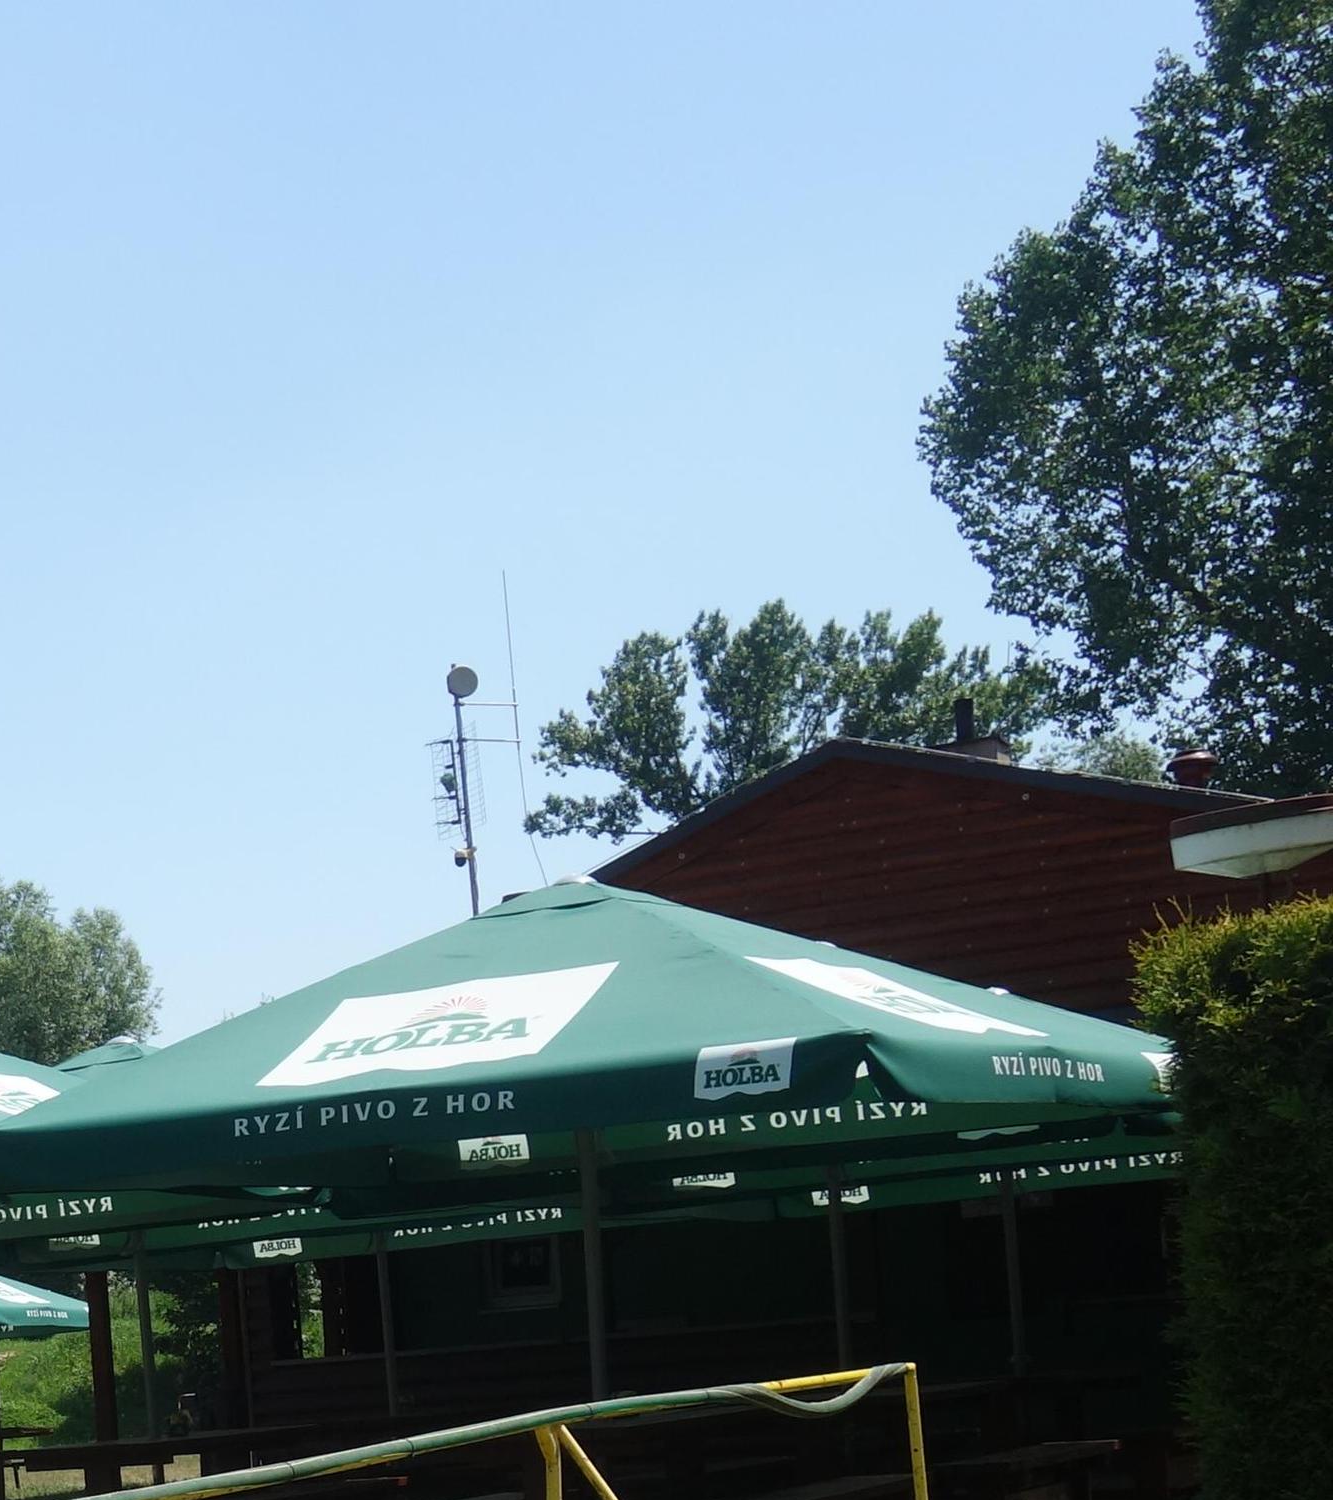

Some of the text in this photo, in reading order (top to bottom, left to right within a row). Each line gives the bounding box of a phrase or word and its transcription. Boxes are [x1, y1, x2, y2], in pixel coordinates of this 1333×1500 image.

[305, 1017, 532, 1063] HOLBA
[703, 1064, 780, 1089] HOLBA
[992, 1052, 1104, 1082] RYZÍ PIVO Z HOR
[233, 1090, 515, 1137] RYZÍ PIVO Z HOR
